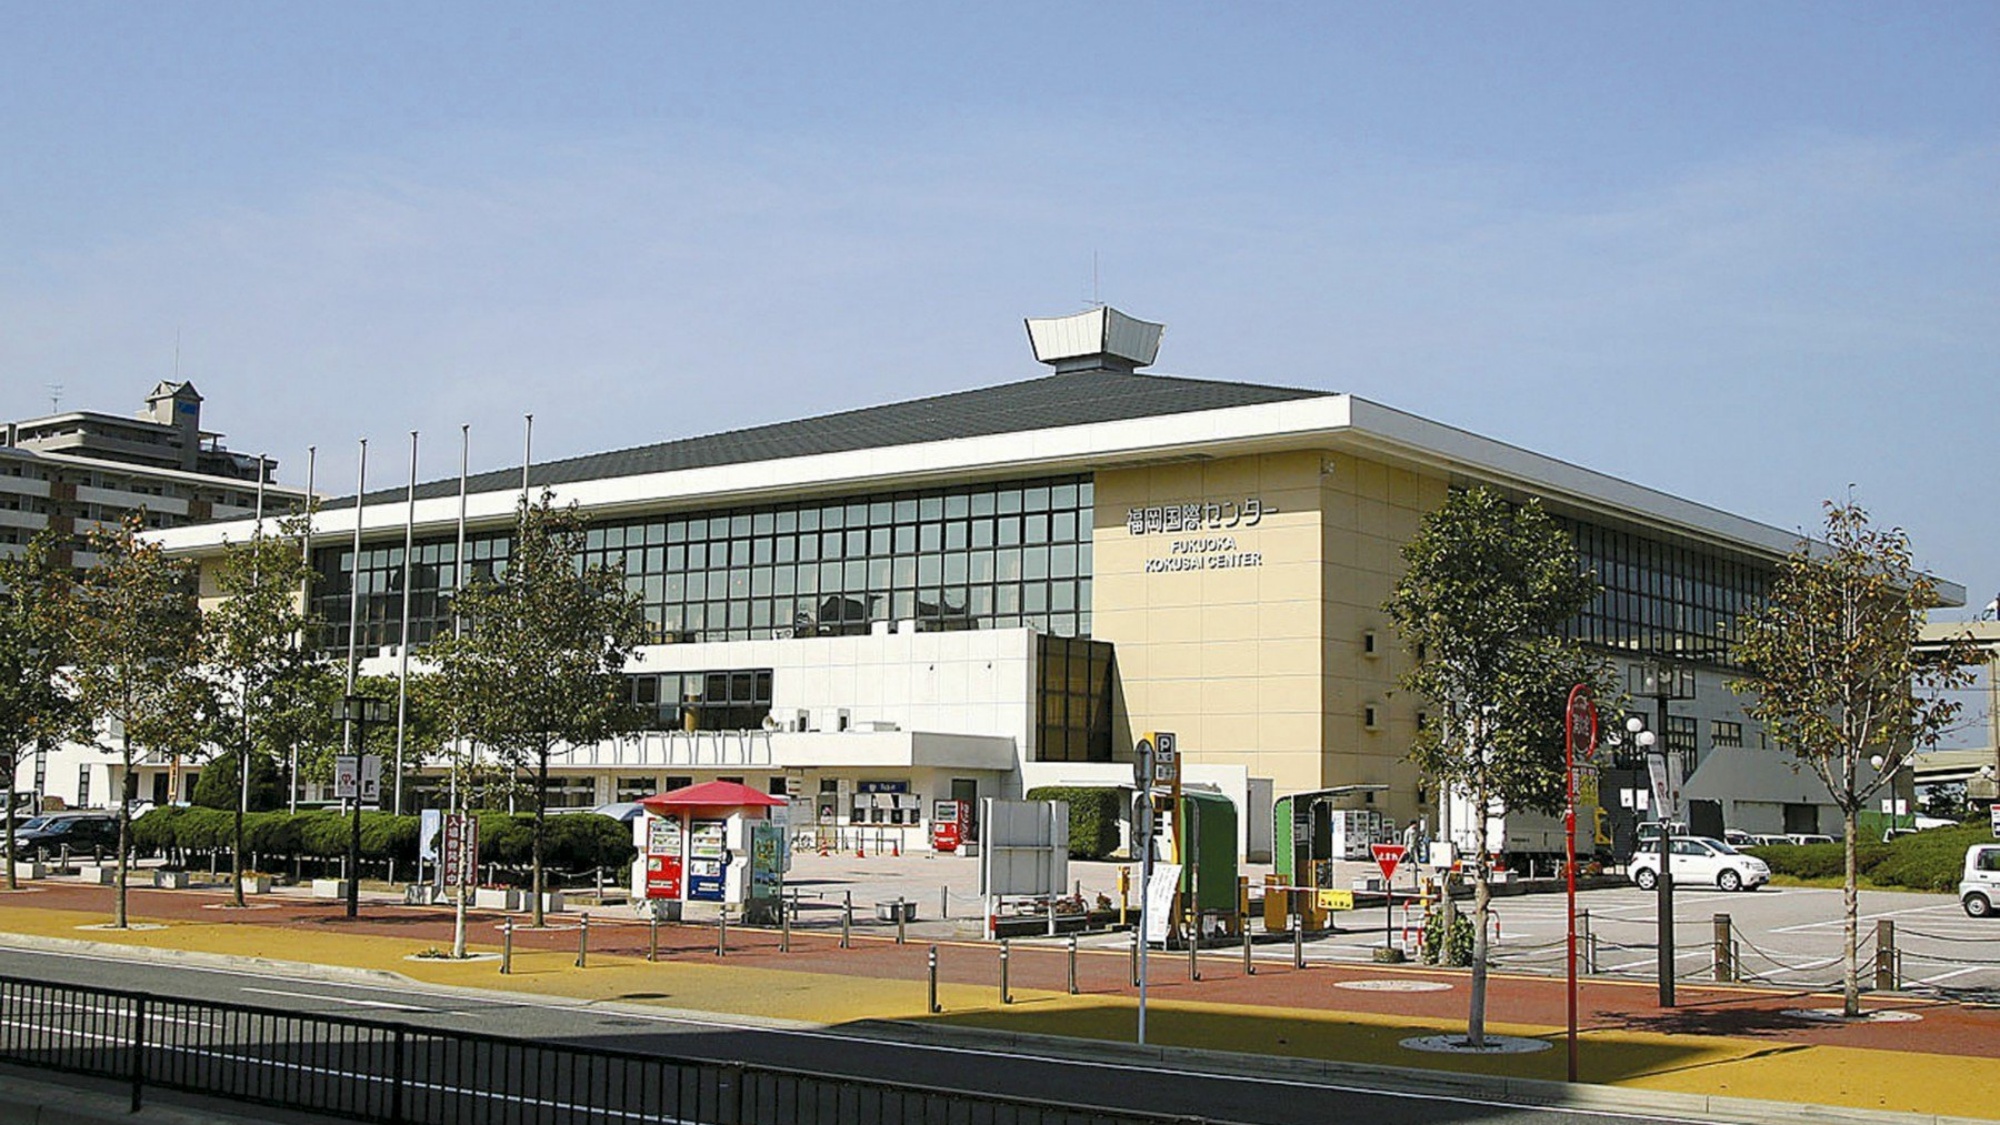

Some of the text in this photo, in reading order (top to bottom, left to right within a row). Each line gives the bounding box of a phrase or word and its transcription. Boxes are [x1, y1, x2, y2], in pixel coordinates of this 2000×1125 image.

[1127, 499, 1278, 535] 福岡国際センター
[1171, 537, 1236, 553] FUKUOKA
[1145, 553, 1262, 573] KOKUSAI CENTER
[1160, 738, 1170, 752] P
